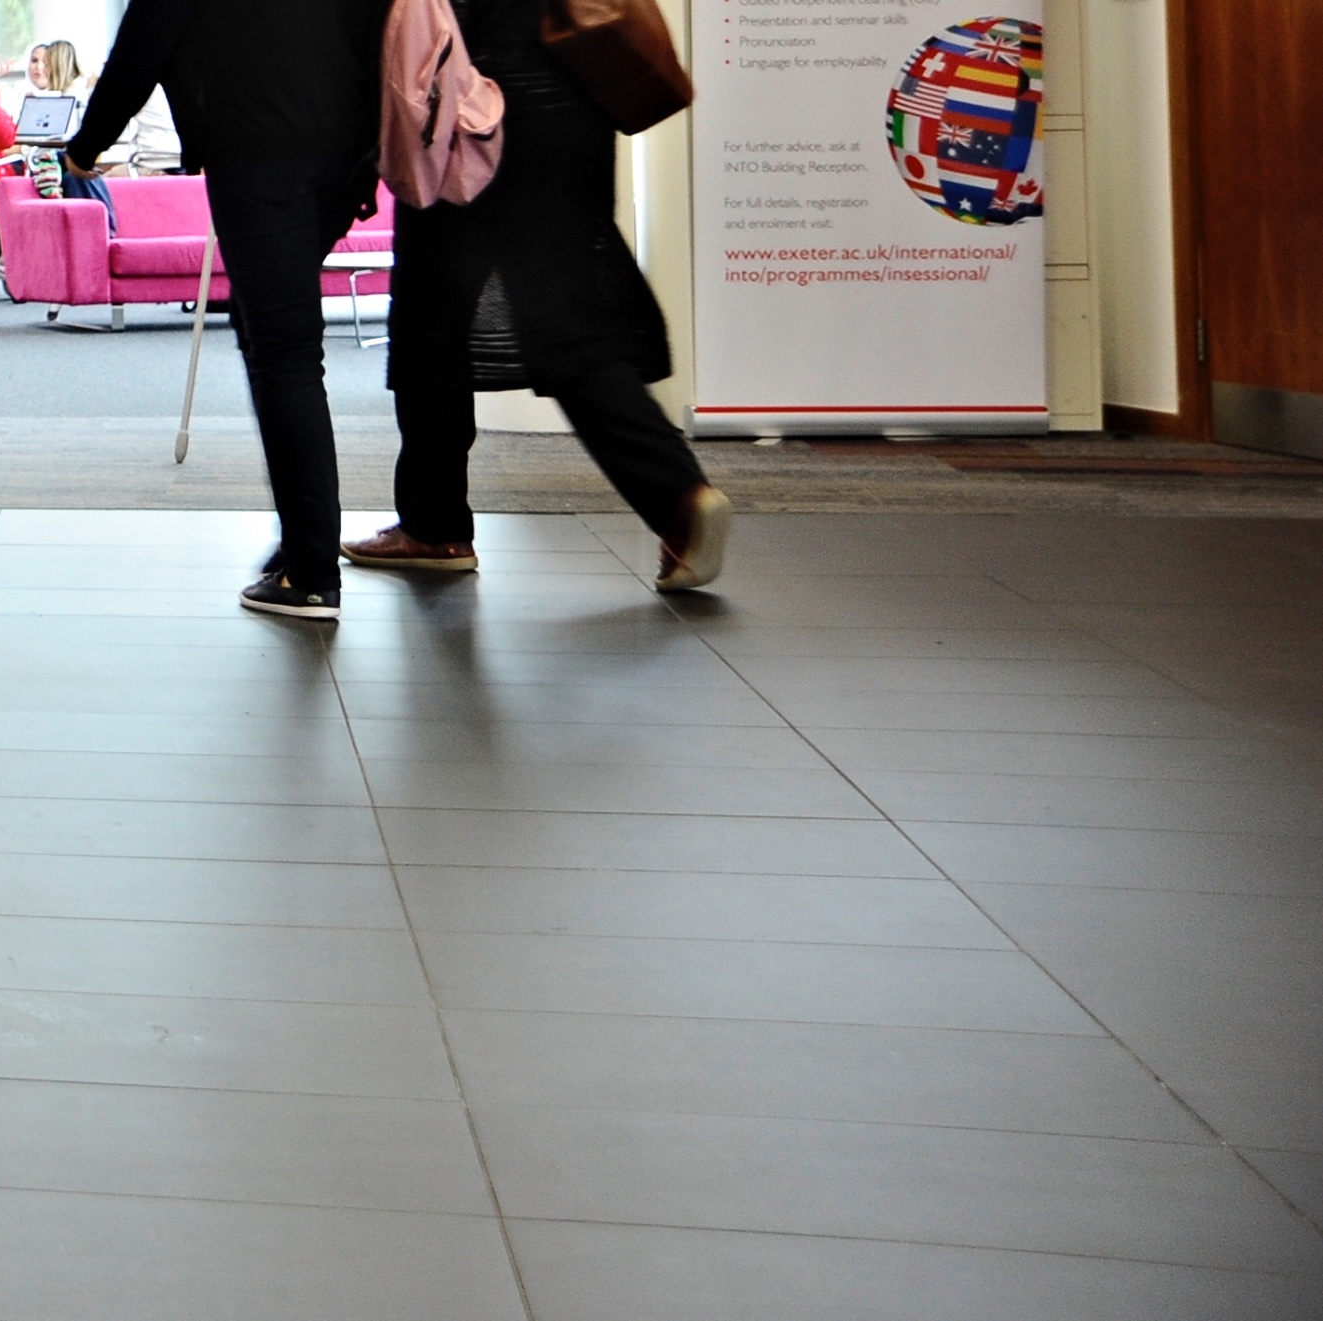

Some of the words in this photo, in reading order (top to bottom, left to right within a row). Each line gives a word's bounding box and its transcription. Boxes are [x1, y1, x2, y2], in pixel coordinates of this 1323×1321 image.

[739, 15, 808, 27] Presentation
[812, 16, 832, 26] and
[835, 15, 880, 26] seminar
[882, 14, 907, 25] skills
[739, 36, 816, 48] Pronunciation
[739, 57, 792, 69] Language
[795, 56, 809, 68] for
[812, 56, 887, 69] employability
[724, 141, 743, 152] For
[746, 140, 782, 151] further
[829, 141, 847, 152] ask
[851, 142, 861, 152] at
[724, 162, 759, 173] INTO
[762, 161, 805, 175] Building
[724, 198, 743, 209] For
[746, 197, 762, 208] full
[806, 198, 868, 211] registration
[724, 218, 744, 229] and
[748, 218, 806, 229] enrolment
[725, 244, 1017, 261] www.exeter.ac.uk/international/
[725, 266, 990, 286] into/programmes/insessional/
